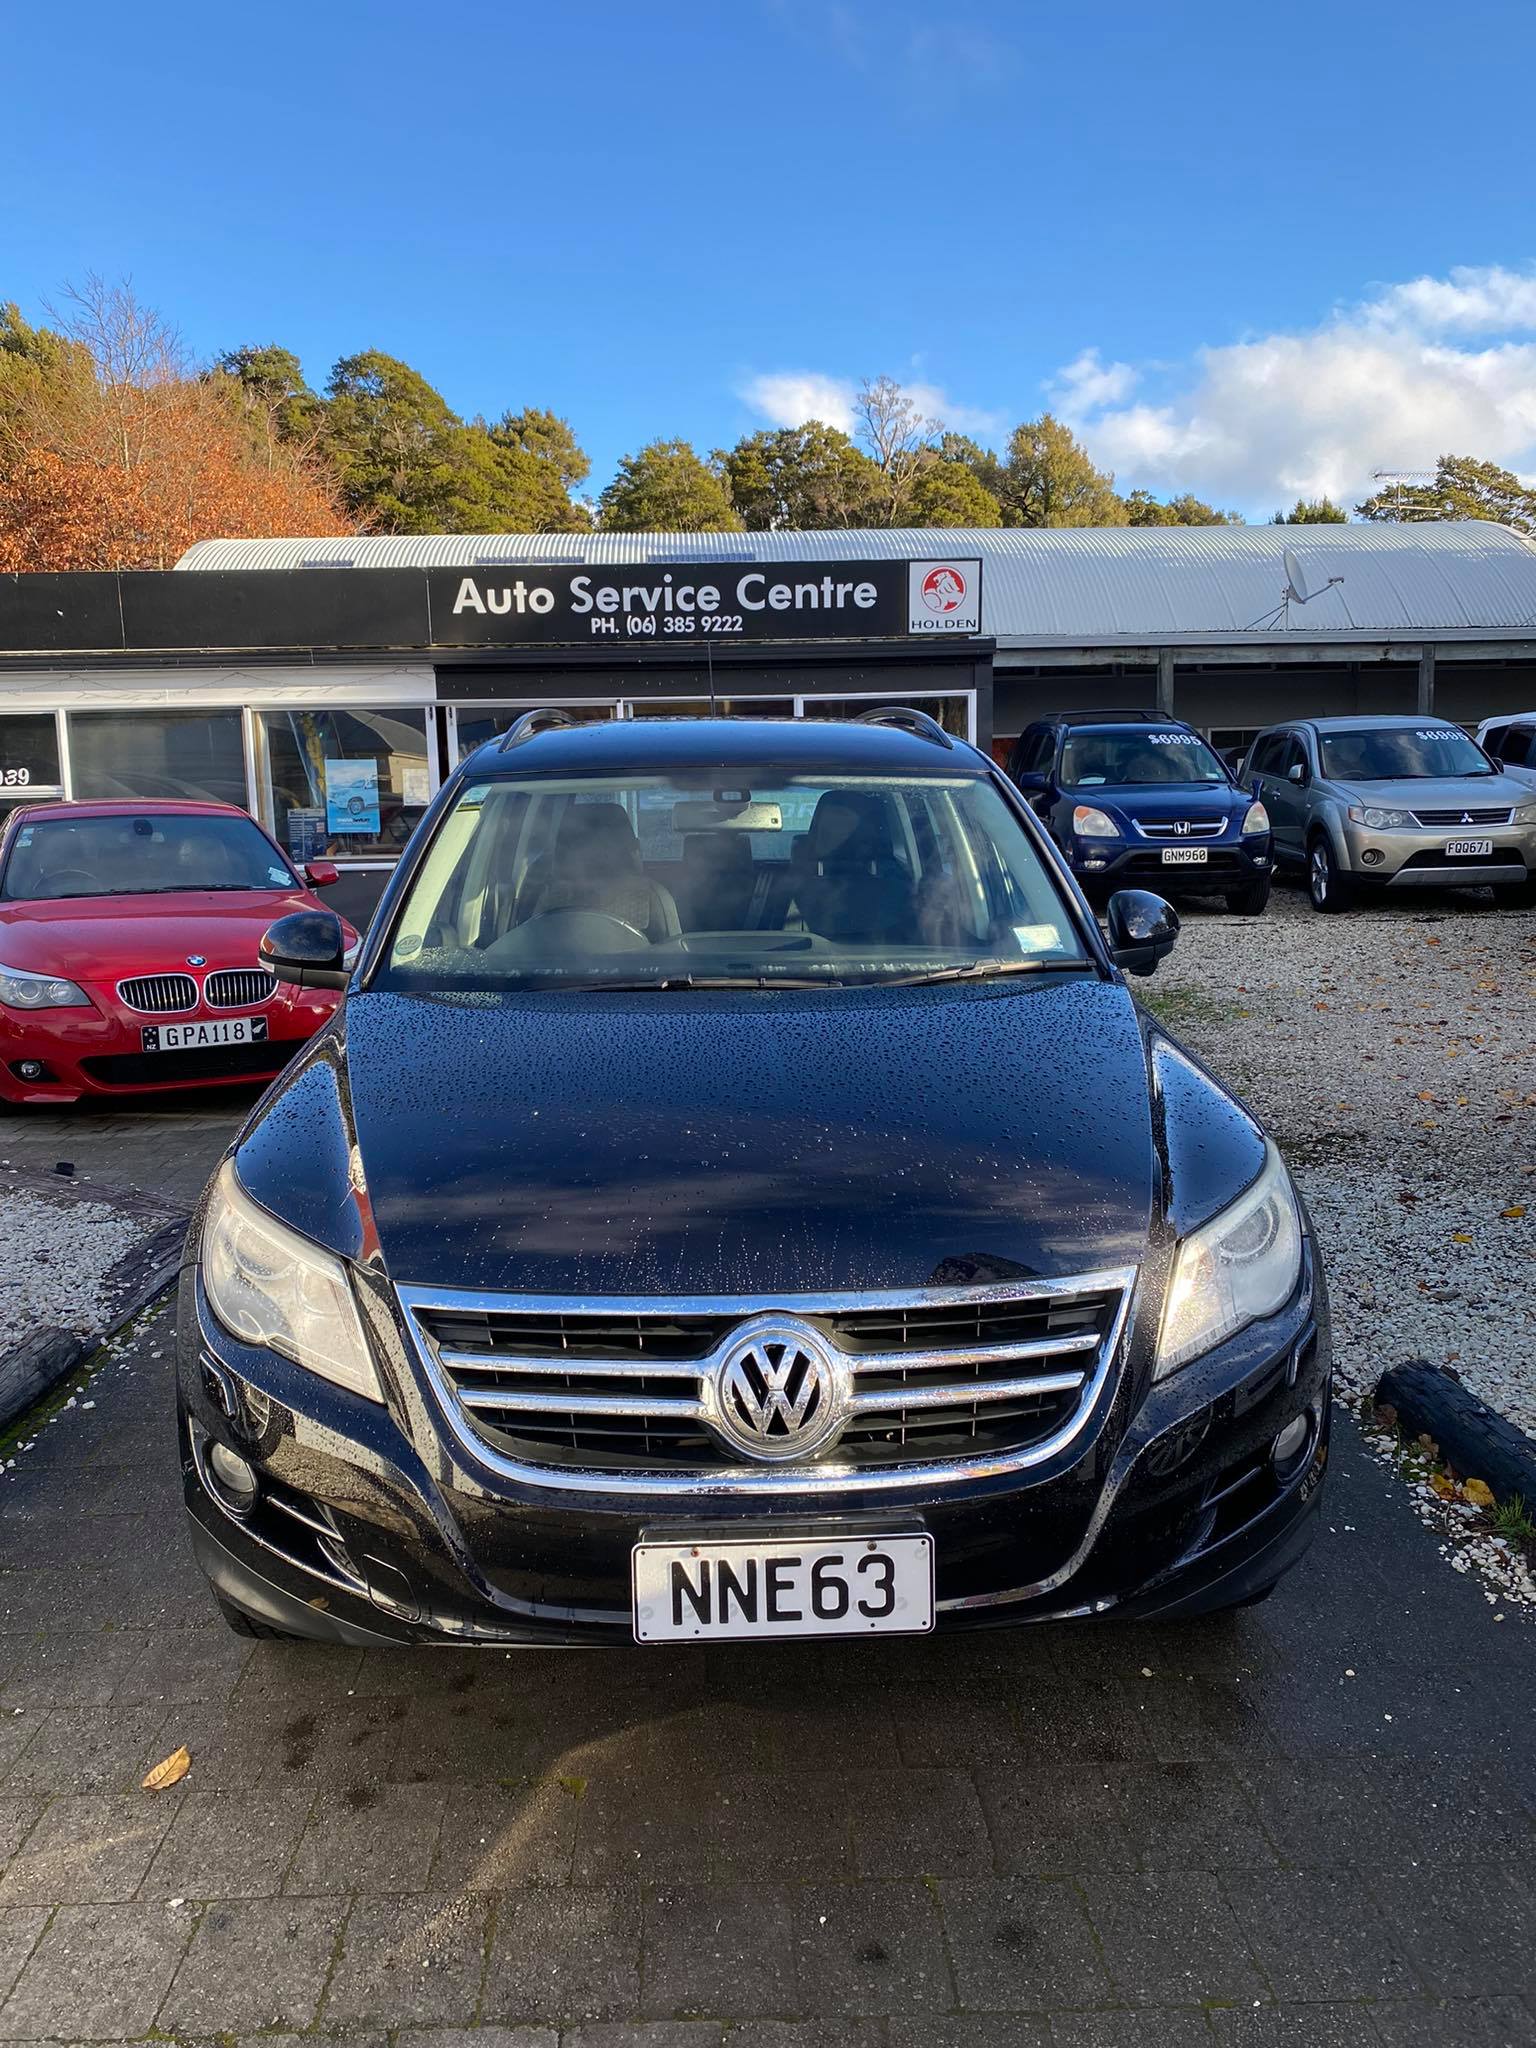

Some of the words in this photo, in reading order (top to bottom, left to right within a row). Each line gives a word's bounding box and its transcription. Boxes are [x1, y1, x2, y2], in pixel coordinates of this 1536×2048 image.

[452, 578, 555, 614] Auto
[570, 573, 721, 613] Service
[736, 573, 878, 610] Centre
[591, 617, 620, 634] PH.
[627, 615, 657, 635] (06)
[664, 617, 695, 633] 385
[702, 615, 743, 632] 9222
[911, 619, 977, 629] HOLDEN
[1148, 734, 1202, 746] $6995
[1164, 850, 1206, 862] GNM960
[166, 1022, 245, 1046] GPA118
[671, 1553, 896, 1626] NNE63
